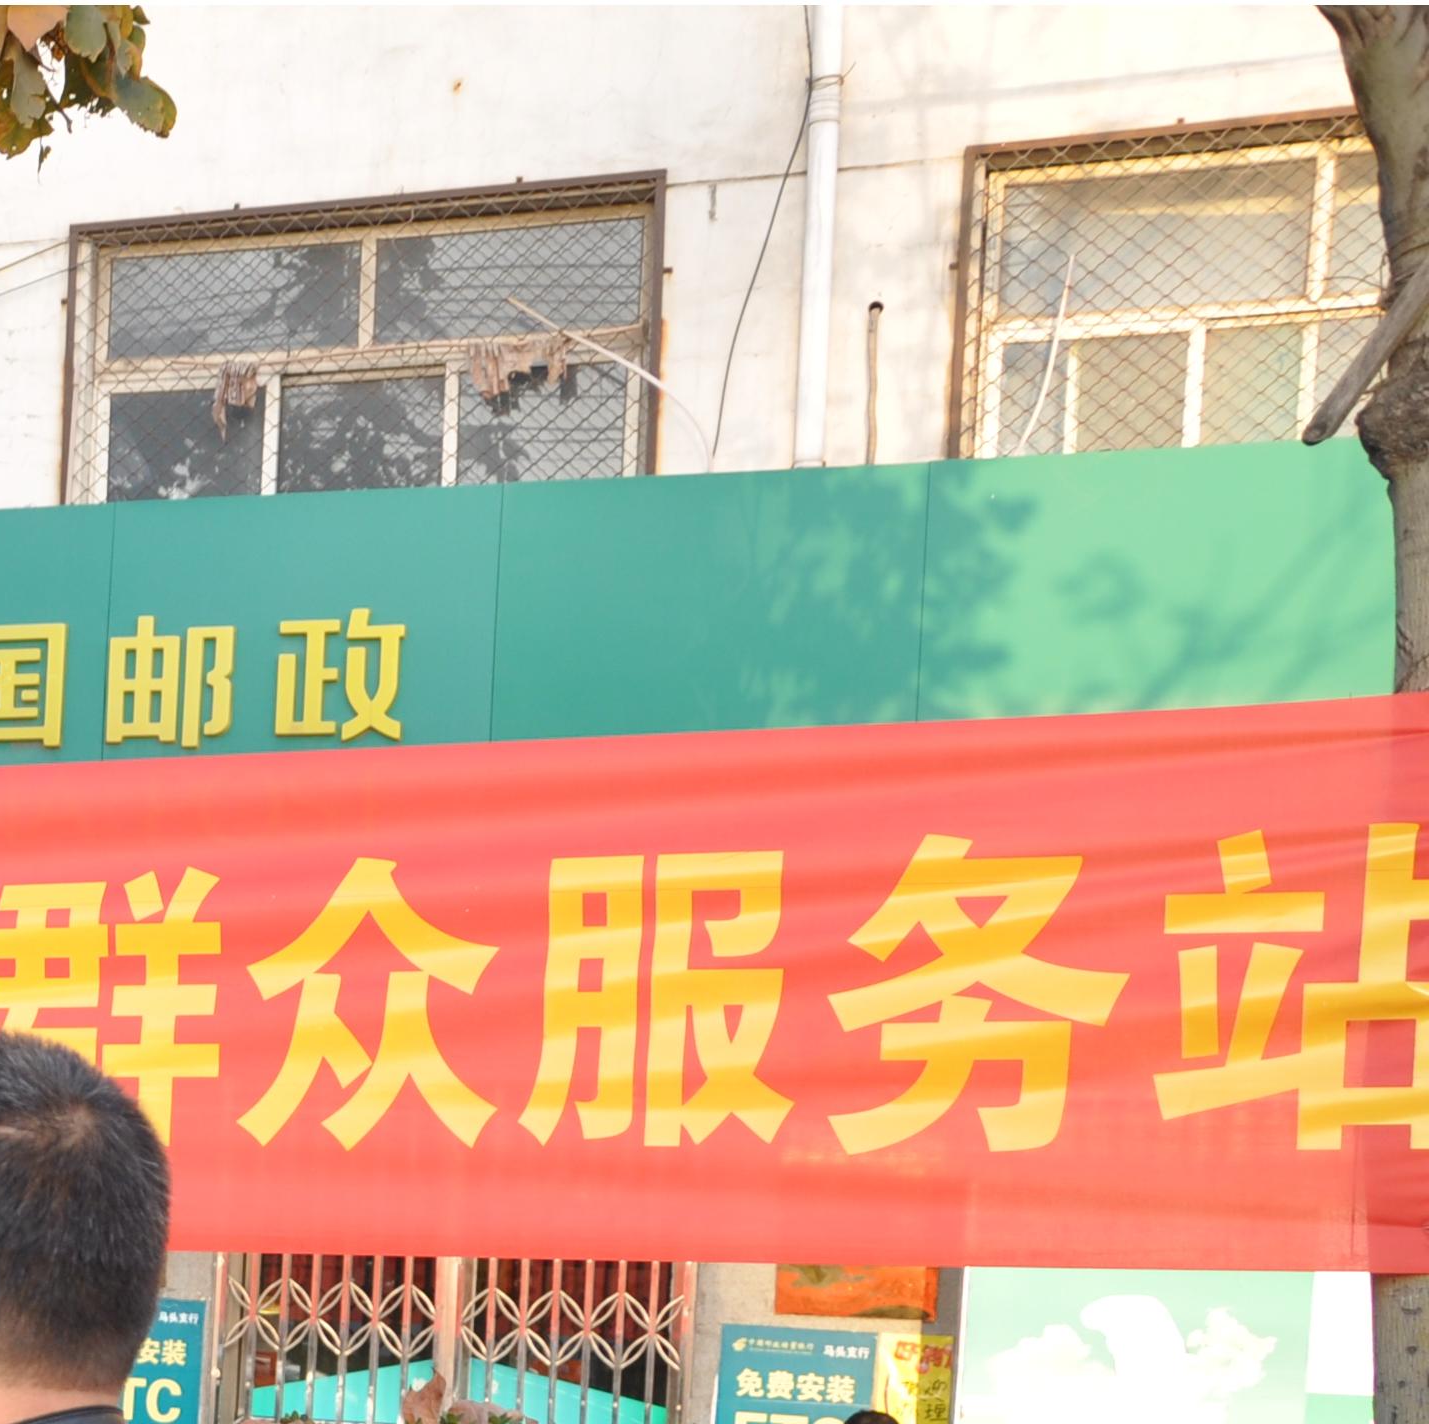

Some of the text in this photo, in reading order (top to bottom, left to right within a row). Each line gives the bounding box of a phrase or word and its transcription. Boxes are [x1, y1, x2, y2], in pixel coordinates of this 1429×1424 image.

[822, 1344, 871, 1360] 马头支行
[735, 1367, 857, 1405] 免费安装
